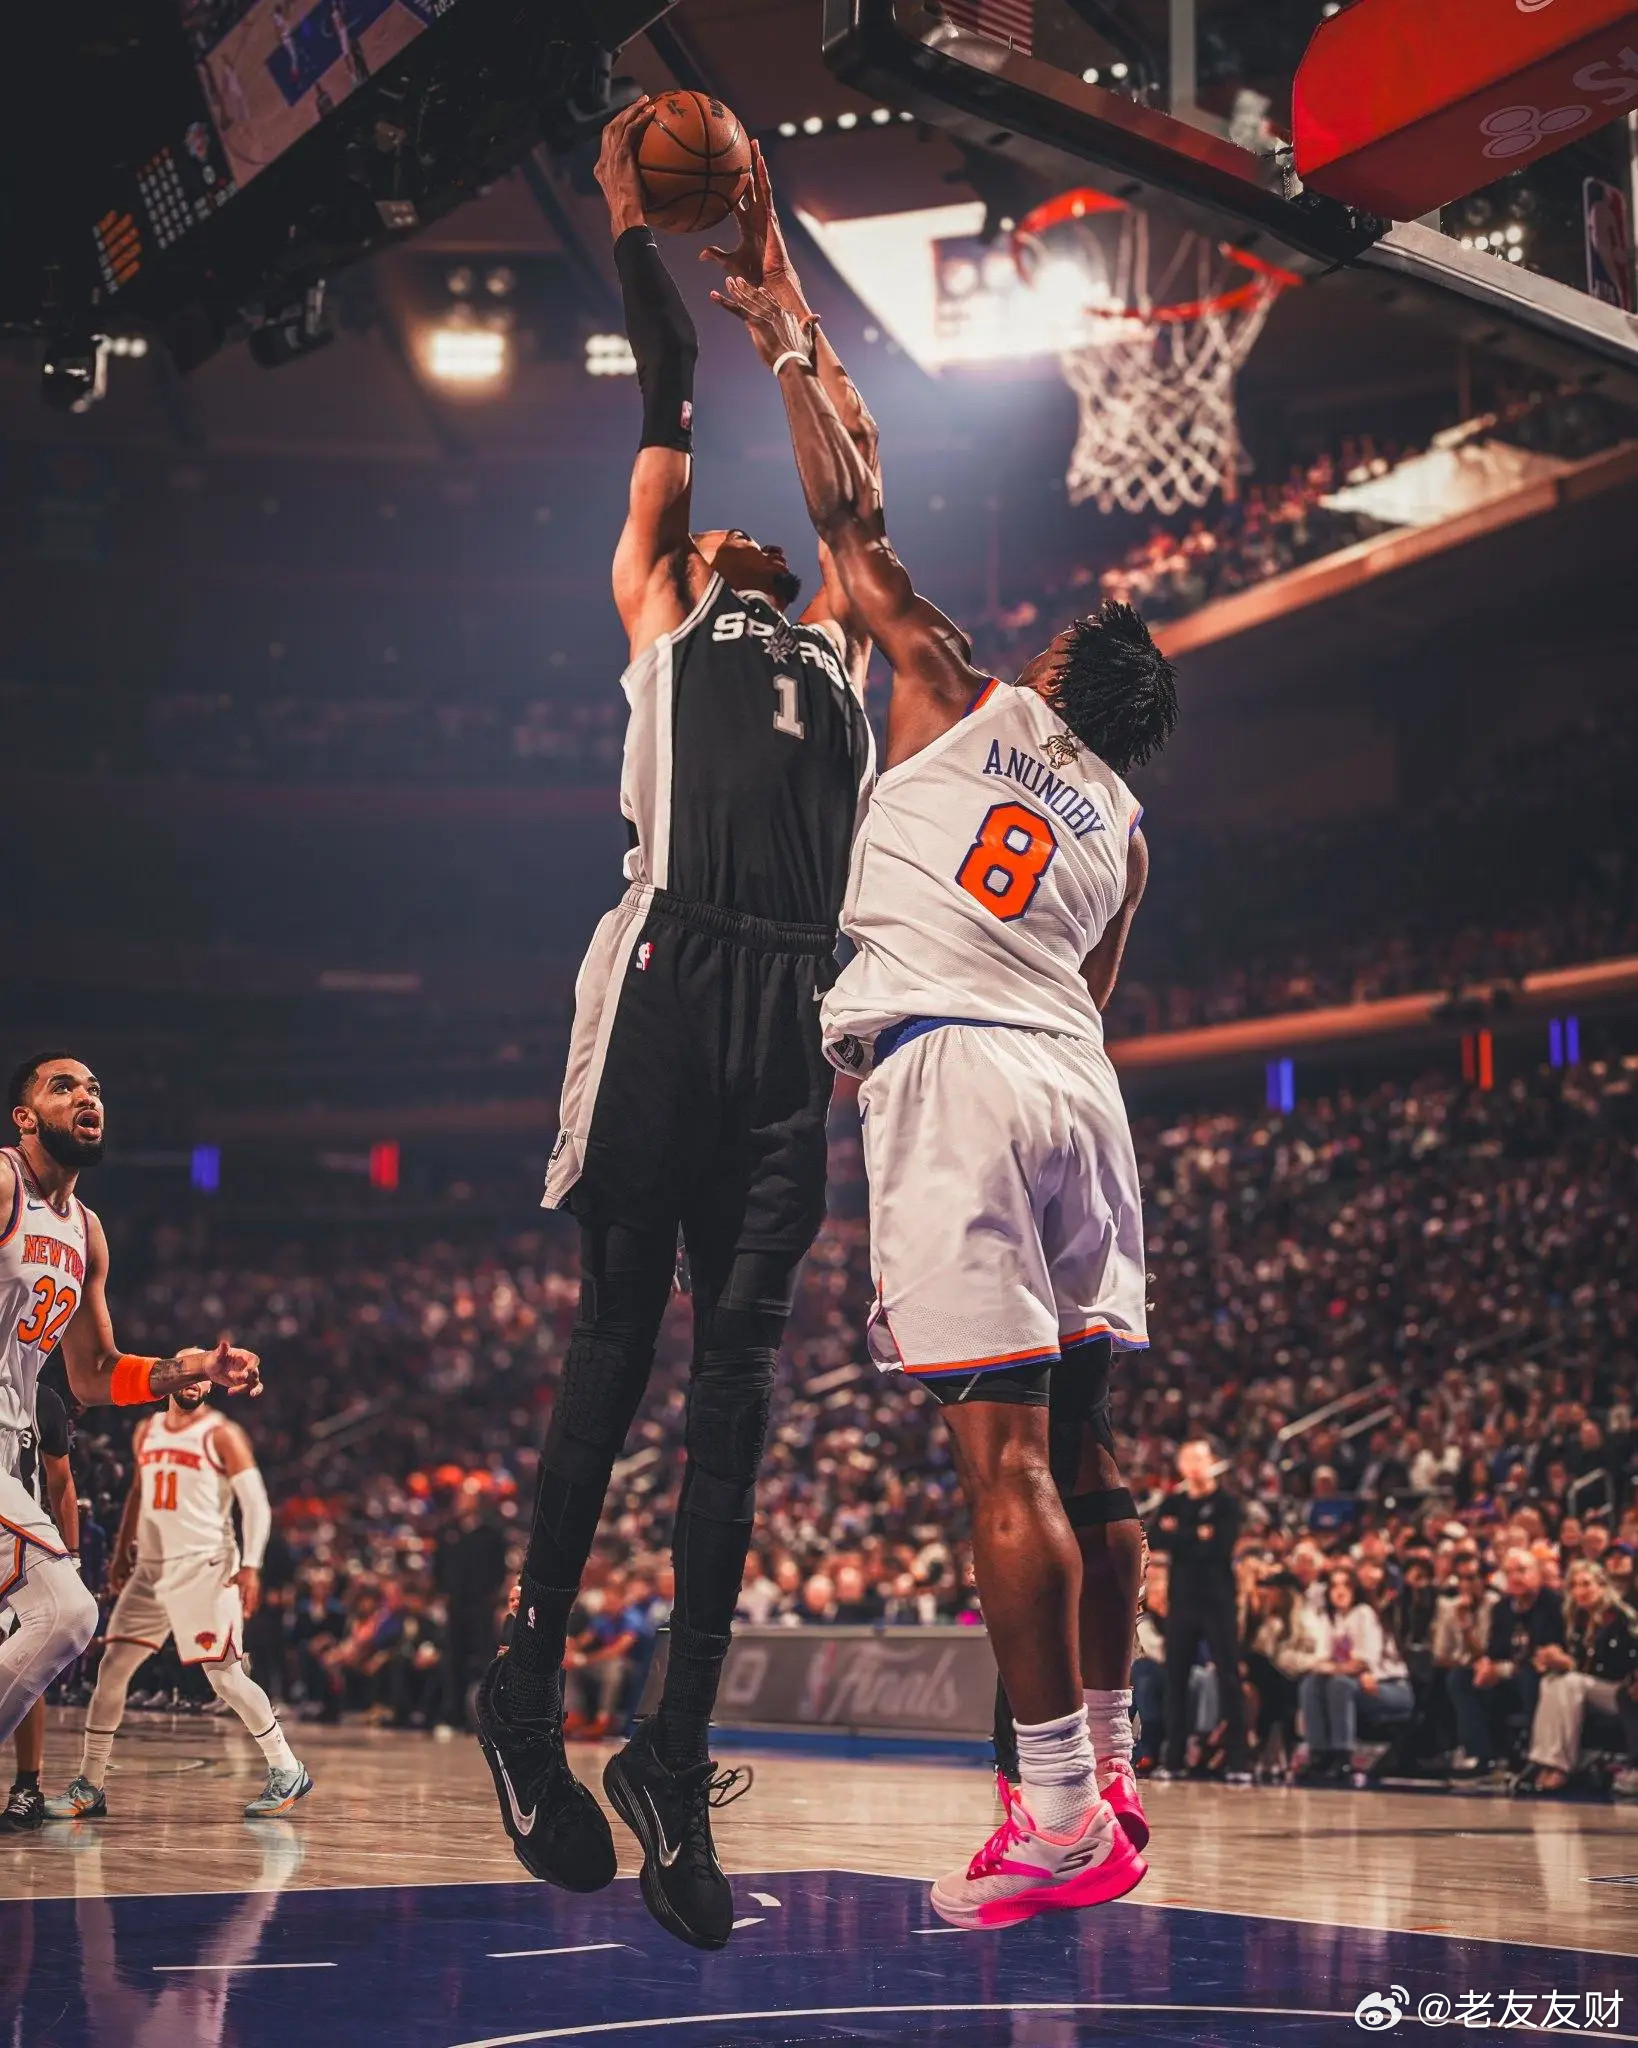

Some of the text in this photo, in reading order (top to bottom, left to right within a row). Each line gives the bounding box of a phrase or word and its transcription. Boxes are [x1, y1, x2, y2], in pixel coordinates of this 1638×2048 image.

[773, 673, 805, 740] 1
[982, 738, 1106, 840] ANUNOBY
[954, 800, 1060, 922] 8
[21, 1233, 62, 1269] NEW
[16, 1274, 77, 1354] 32
[153, 1470, 178, 1510] 11
